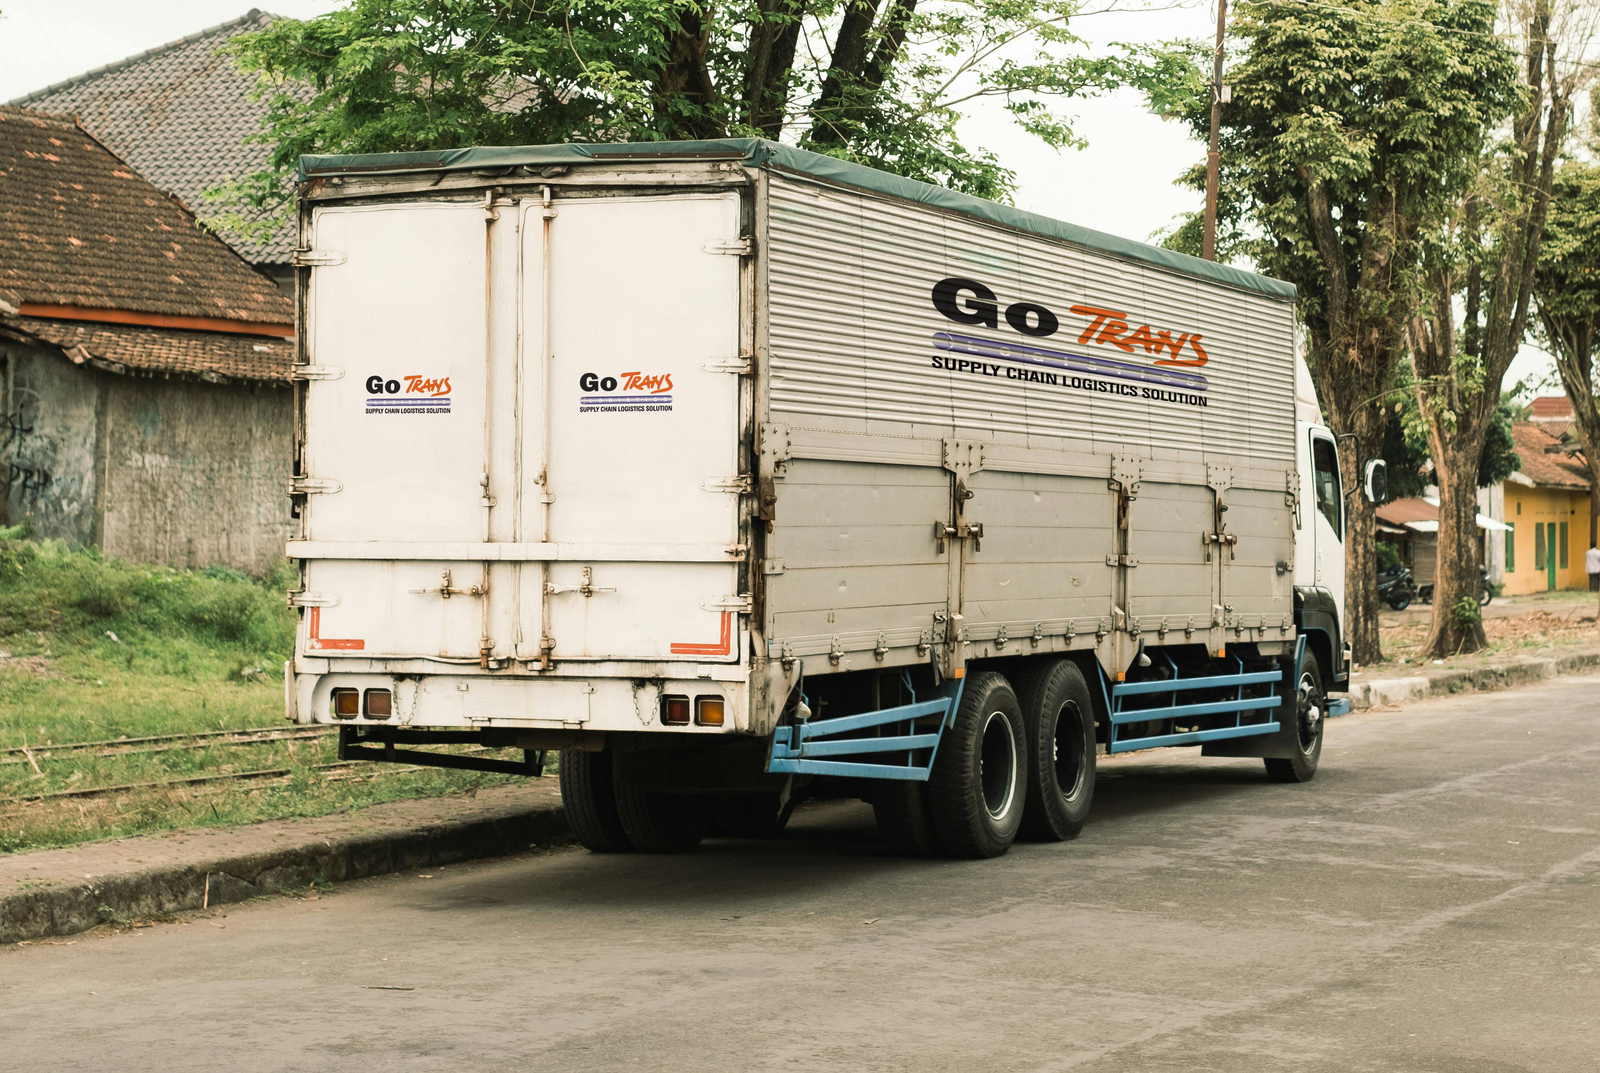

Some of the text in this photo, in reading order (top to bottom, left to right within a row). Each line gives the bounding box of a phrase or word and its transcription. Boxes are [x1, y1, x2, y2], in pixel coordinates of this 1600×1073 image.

[931, 277, 1209, 367] Go TRANS
[365, 374, 452, 397] Go TRANS
[579, 371, 674, 394] Go TRANS
[931, 355, 1208, 407] SUPPLY CHAIN LOGISTICS SOLUTION
